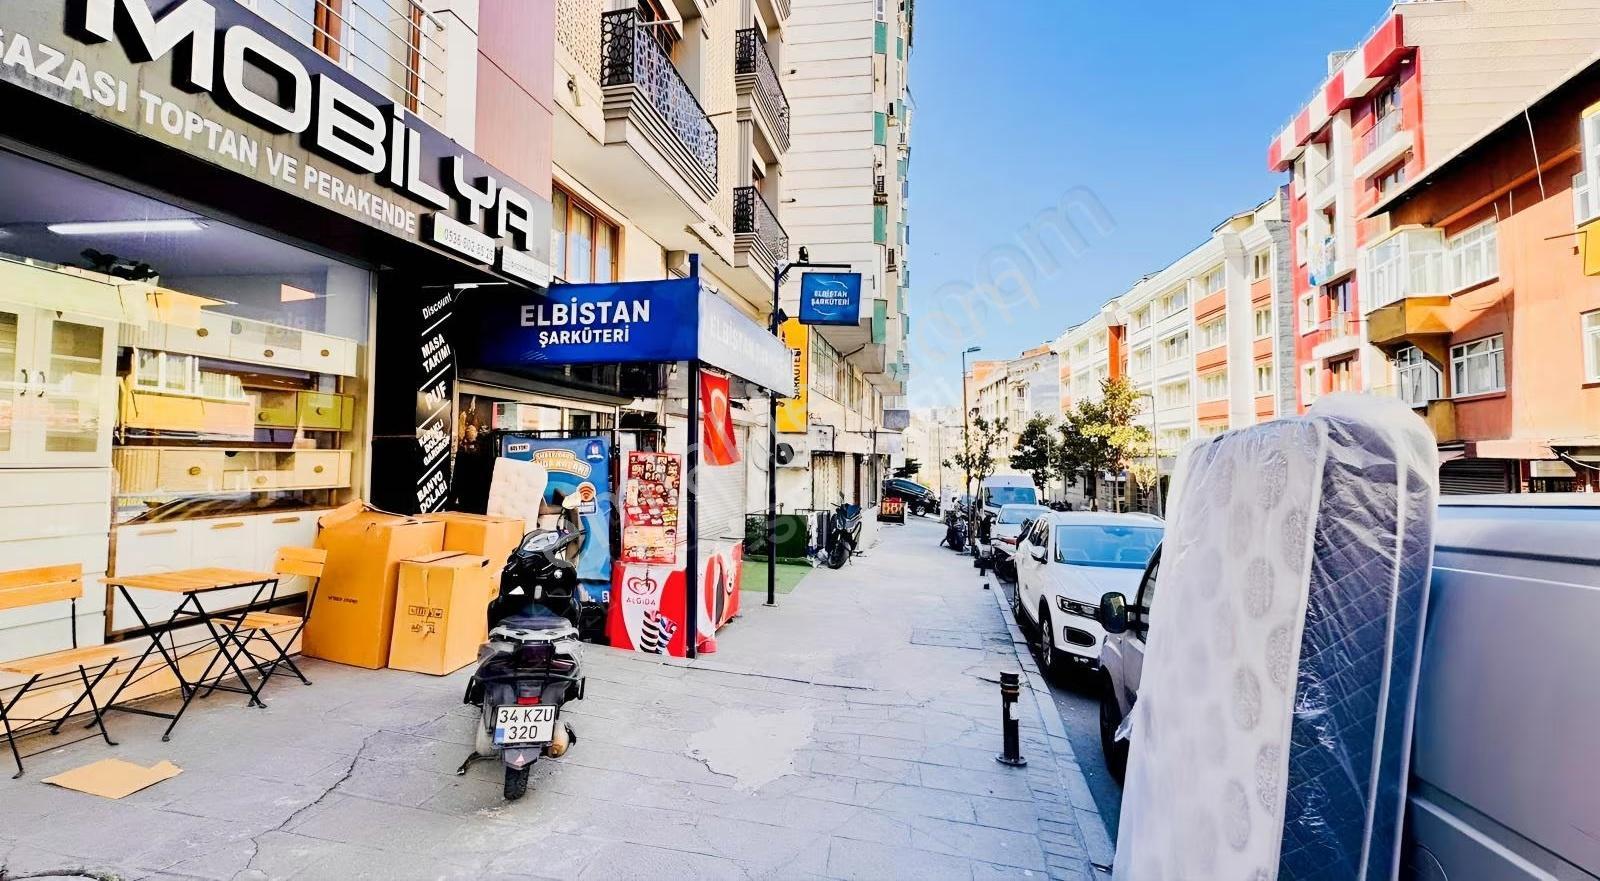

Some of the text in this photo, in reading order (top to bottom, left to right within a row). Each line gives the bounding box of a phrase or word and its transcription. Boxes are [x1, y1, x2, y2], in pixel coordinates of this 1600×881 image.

[0, 29, 416, 234] AZASI TOPTAN VE PERAKENDE
[85, 0, 534, 251] MOBİLYA
[422, 291, 452, 320] Discount
[811, 297, 850, 307] ŞARKÜTERİ
[813, 289, 848, 298] ELBİSTAN
[520, 297, 650, 327] ELBİSTAN
[421, 333, 445, 359] MASA
[539, 325, 630, 348] ŞARKÜTERİ
[422, 343, 451, 373] TAKIMI
[425, 380, 447, 410] PUF
[416, 470, 443, 502] BANYO
[420, 479, 447, 513] DOLABI
[500, 708, 553, 723] 34 KZU
[509, 725, 538, 739] 320
